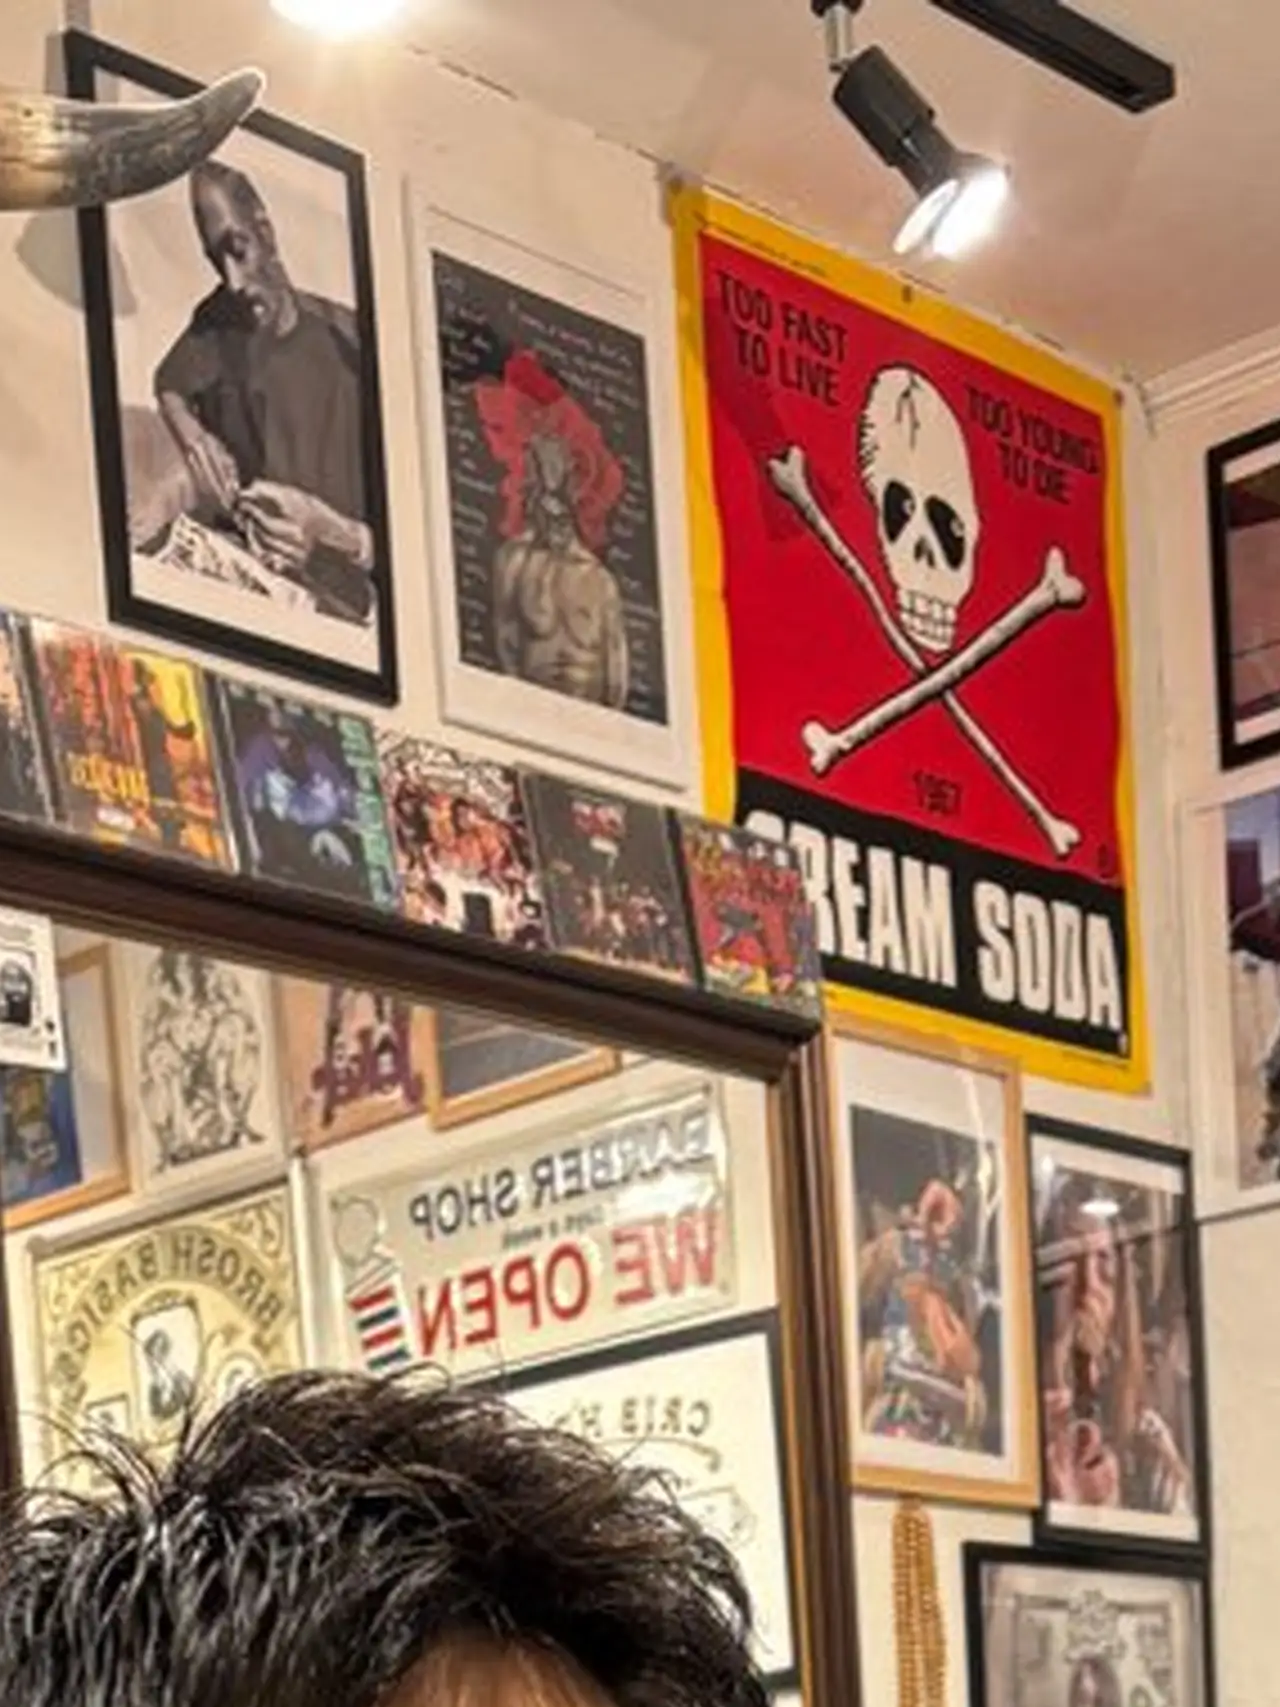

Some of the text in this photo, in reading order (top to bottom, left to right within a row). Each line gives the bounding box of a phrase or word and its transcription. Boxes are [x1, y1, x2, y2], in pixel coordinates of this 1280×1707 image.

[718, 268, 848, 363] TOO FAST
[736, 329, 841, 408] TO LIVE
[964, 383, 1012, 437] TOO
[996, 440, 1070, 505] TO DIE
[973, 880, 1121, 1031] SODA
